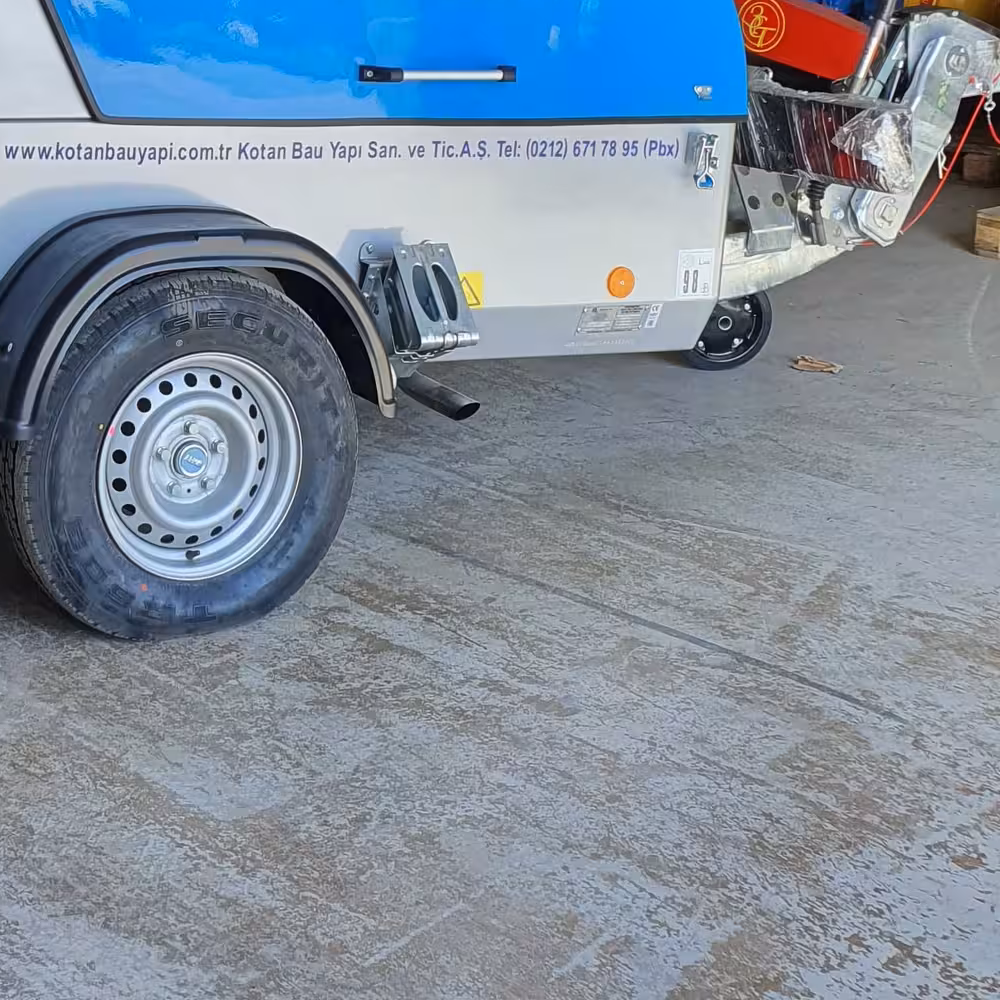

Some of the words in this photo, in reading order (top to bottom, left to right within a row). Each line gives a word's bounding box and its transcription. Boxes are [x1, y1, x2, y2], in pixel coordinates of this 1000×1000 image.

[4, 141, 232, 165] www.kotanbauyapi.com.tr
[237, 142, 286, 160] Kotan
[291, 141, 323, 160] Bau
[367, 140, 402, 159] San.
[407, 145, 426, 159] ve
[496, 140, 521, 158] Tel:
[526, 138, 568, 160] (0212)
[572, 140, 597, 158] 671
[600, 139, 617, 158] 78
[621, 139, 639, 157] 95
[643, 137, 680, 160] (Pbx)
[683, 269, 698, 294] 98
